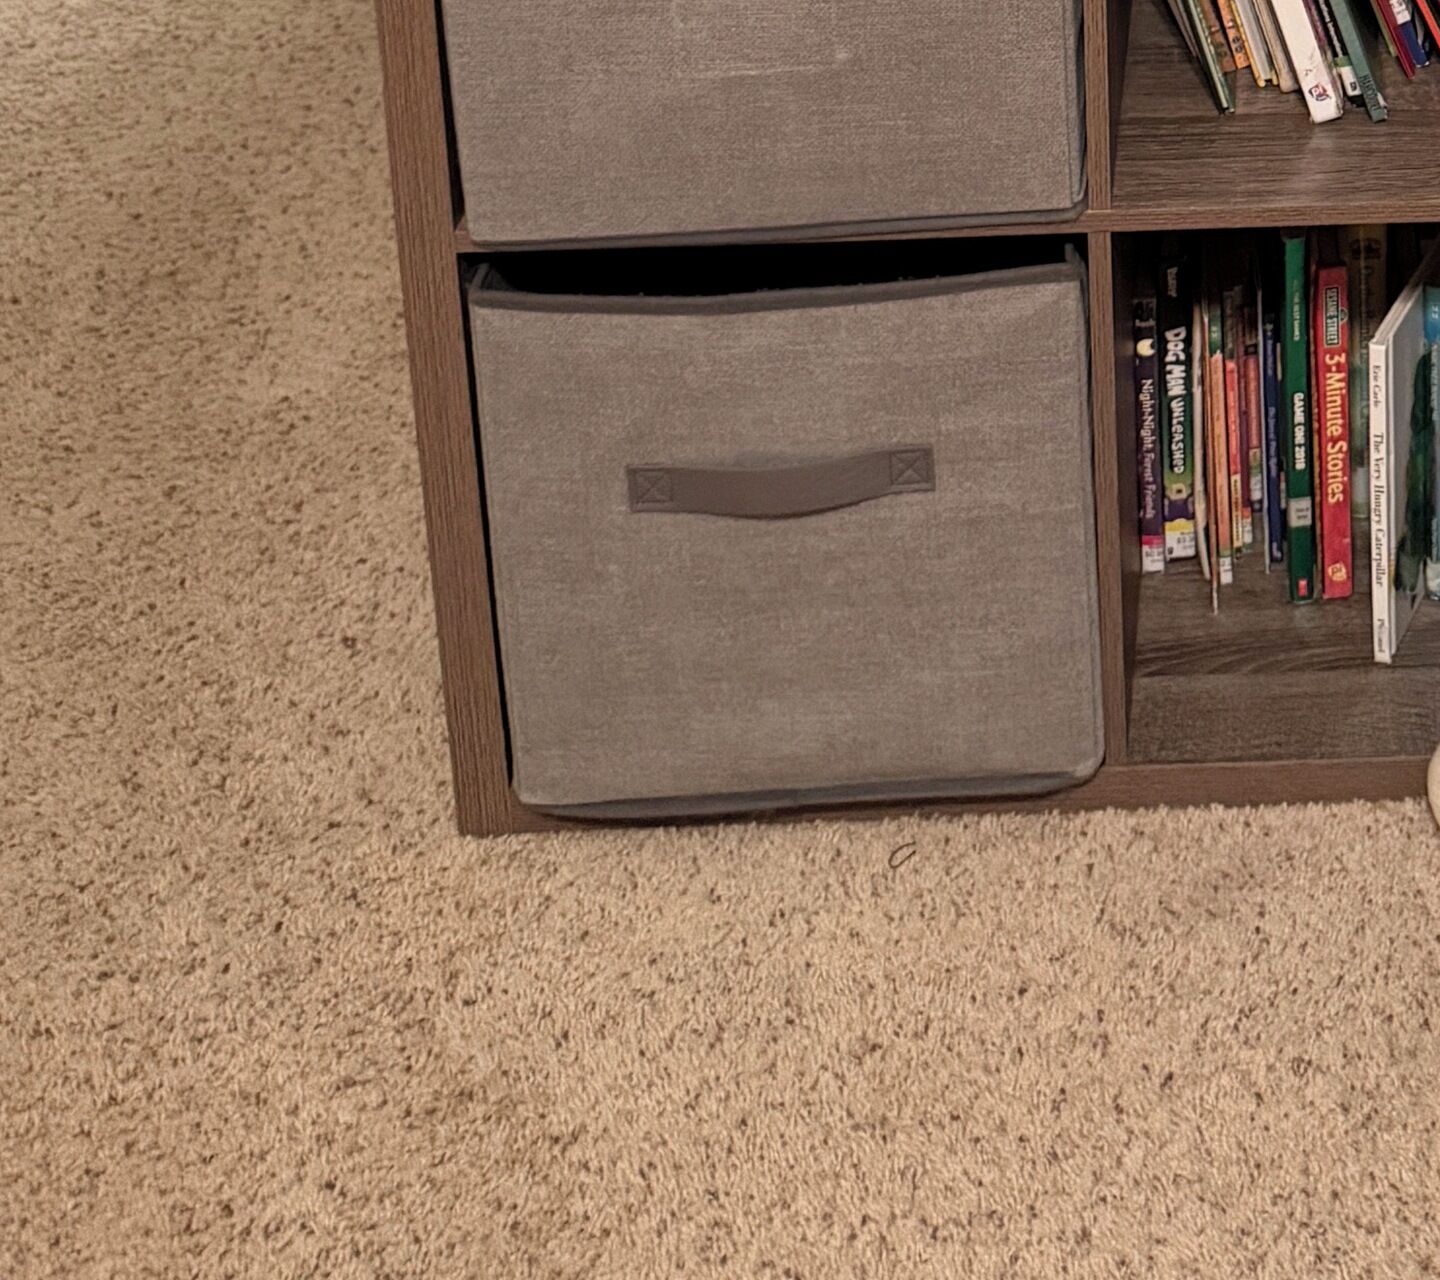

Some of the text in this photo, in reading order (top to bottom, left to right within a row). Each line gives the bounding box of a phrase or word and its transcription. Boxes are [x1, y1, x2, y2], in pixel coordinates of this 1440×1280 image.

[1326, 288, 1338, 344] SESAME STREET
[1164, 326, 1187, 362] DOG
[1165, 363, 1187, 397] MAN
[1373, 365, 1381, 382] Eric
[1293, 392, 1304, 425] GAME
[1325, 353, 1348, 504] 3-Minute Stories
[1373, 433, 1387, 586] The Very Hungry Caterpillar
